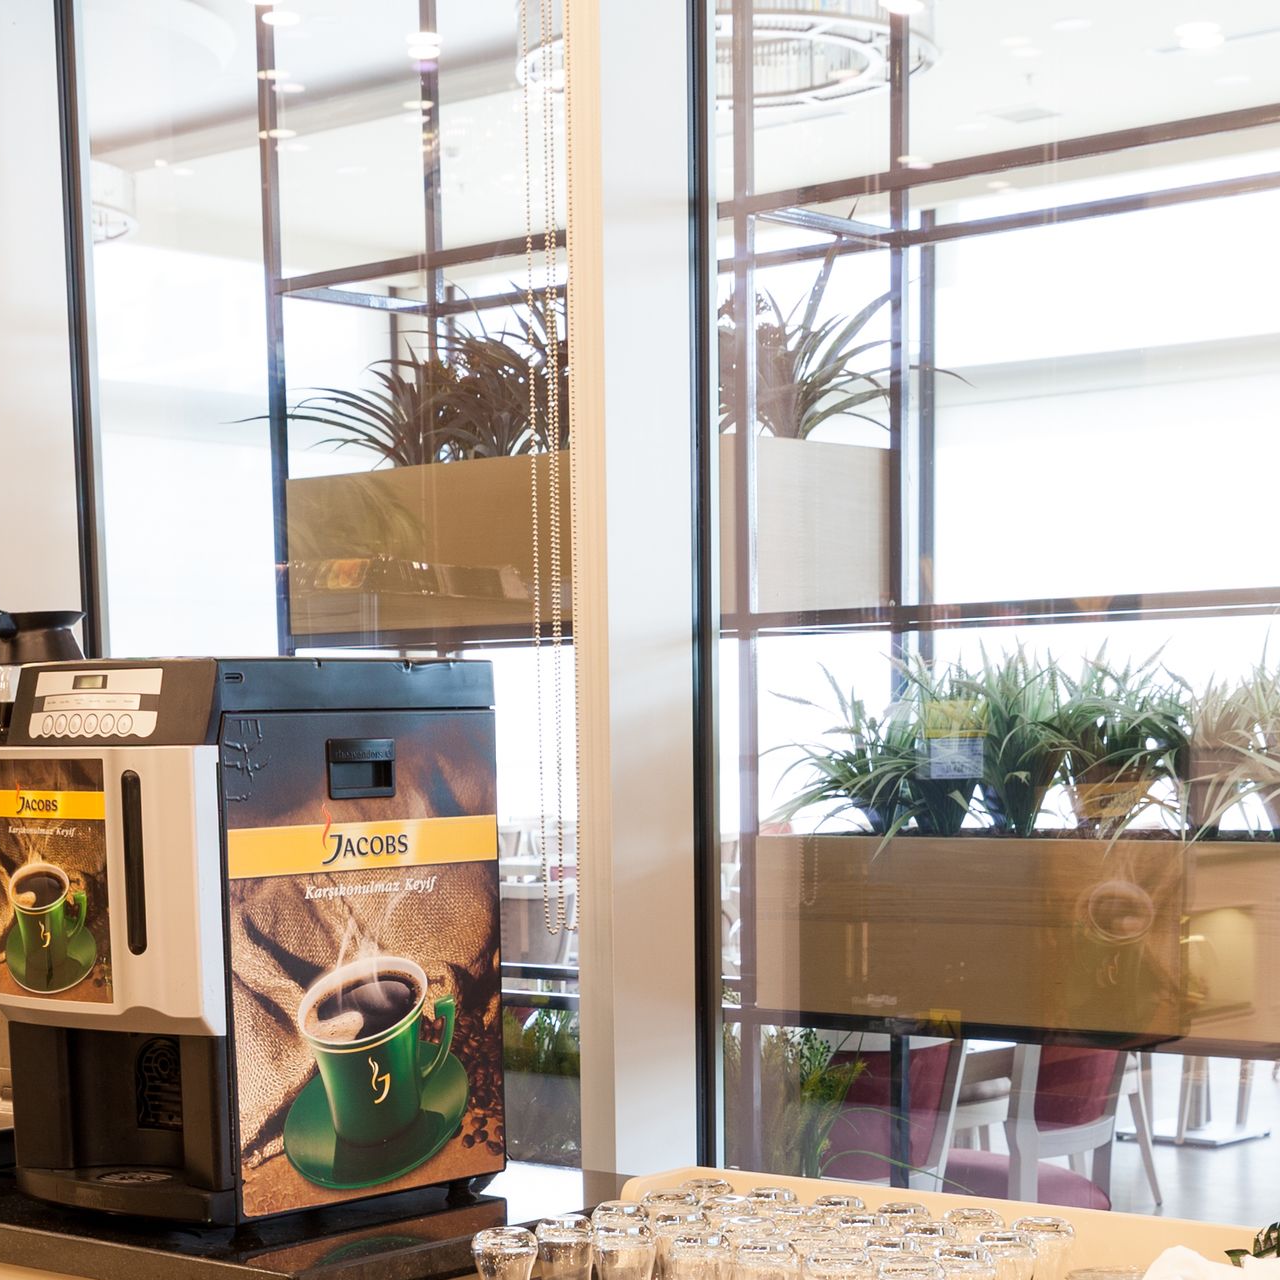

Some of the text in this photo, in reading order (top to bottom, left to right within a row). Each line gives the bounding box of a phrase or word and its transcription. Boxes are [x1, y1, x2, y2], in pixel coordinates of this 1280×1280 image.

[16, 796, 58, 814] JACOBS
[322, 833, 409, 865] JACOBS
[304, 875, 438, 900] Karşıkonulmaz Keyif
